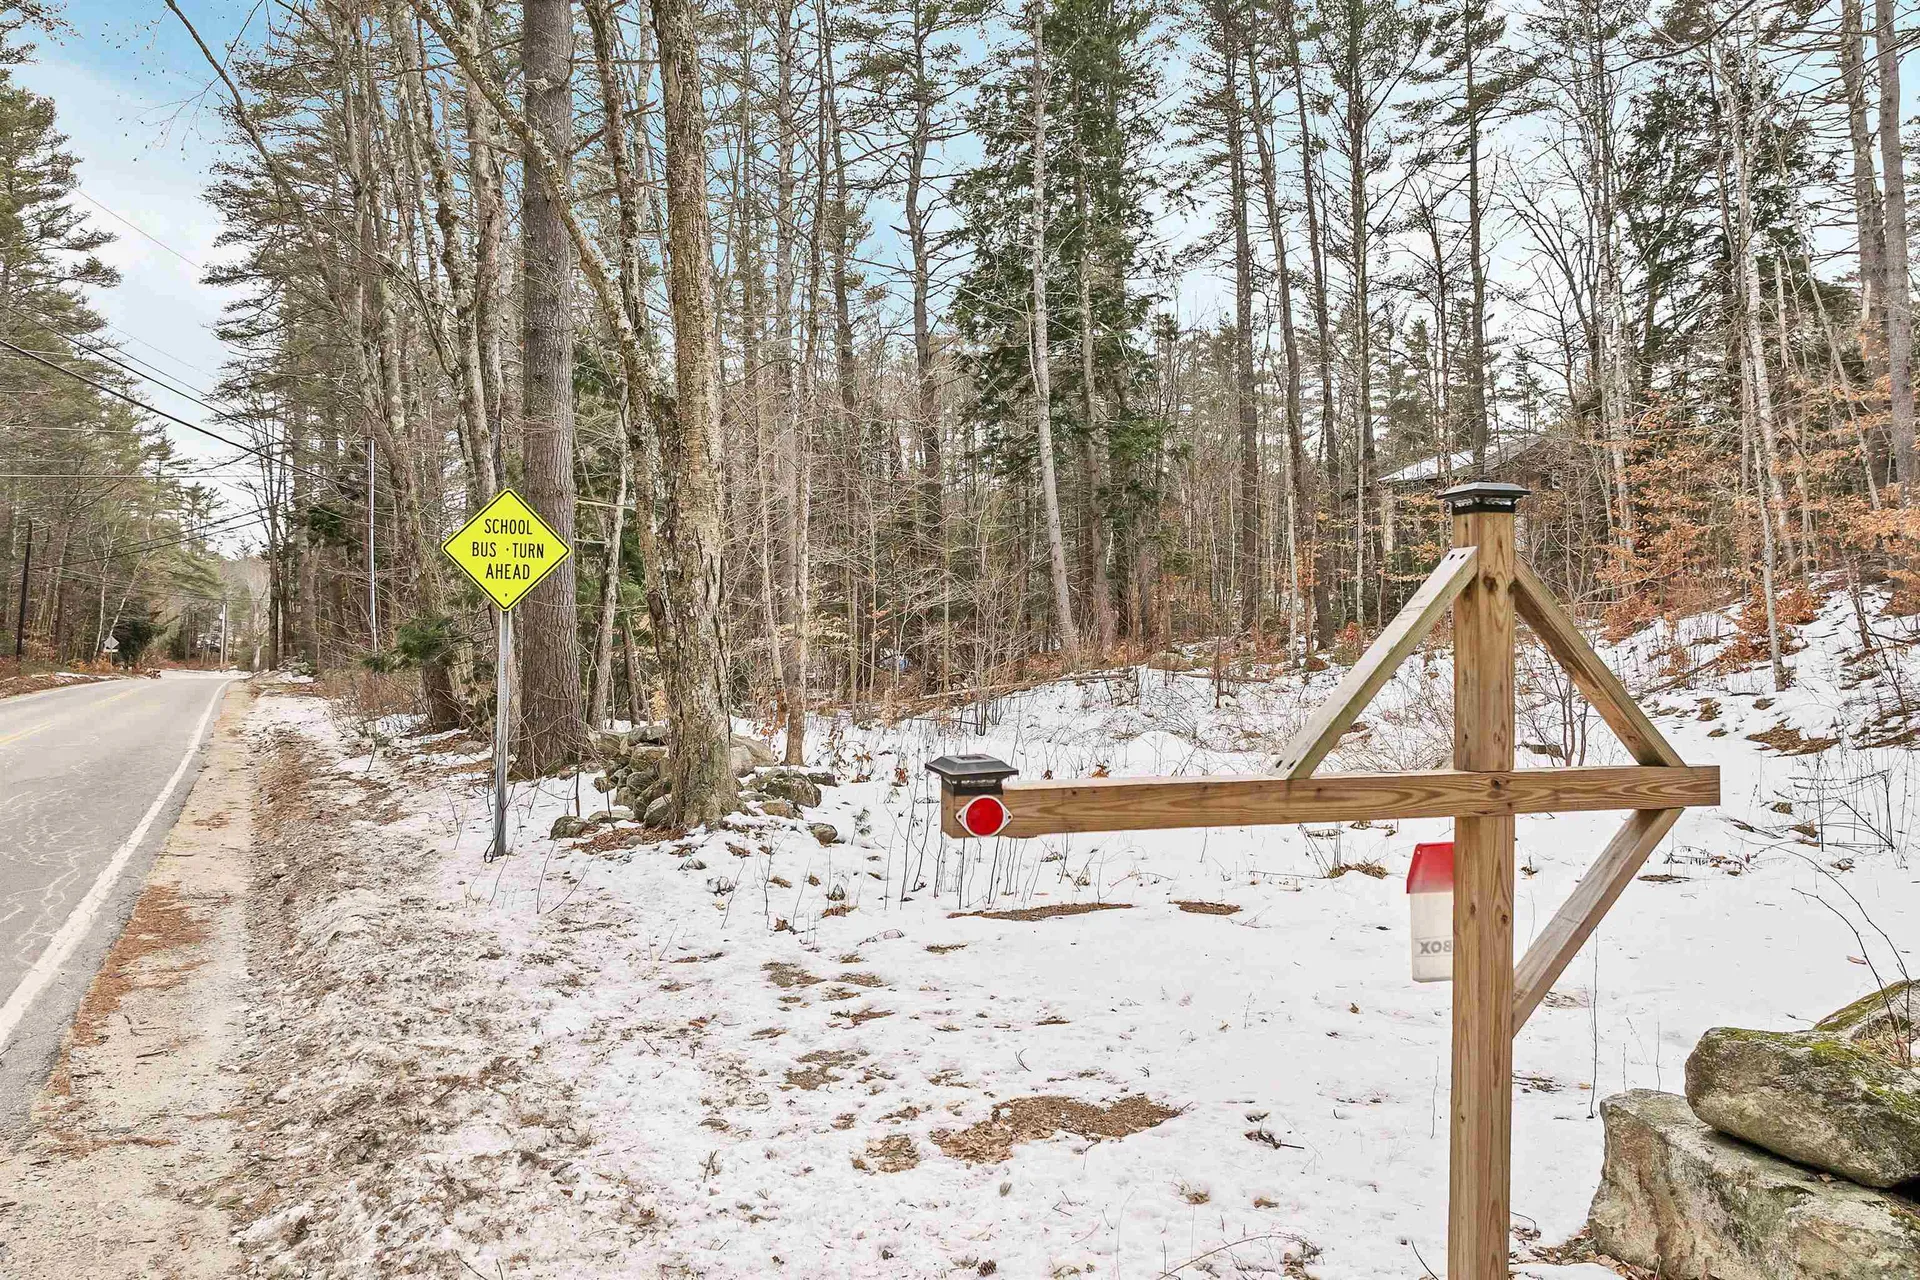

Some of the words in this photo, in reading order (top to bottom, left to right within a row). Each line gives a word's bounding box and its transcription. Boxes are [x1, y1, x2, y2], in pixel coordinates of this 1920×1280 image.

[484, 518, 533, 535] SCHOOL
[472, 541, 497, 558] BUS
[512, 542, 544, 559] TURN
[485, 563, 530, 580] AHEAD
